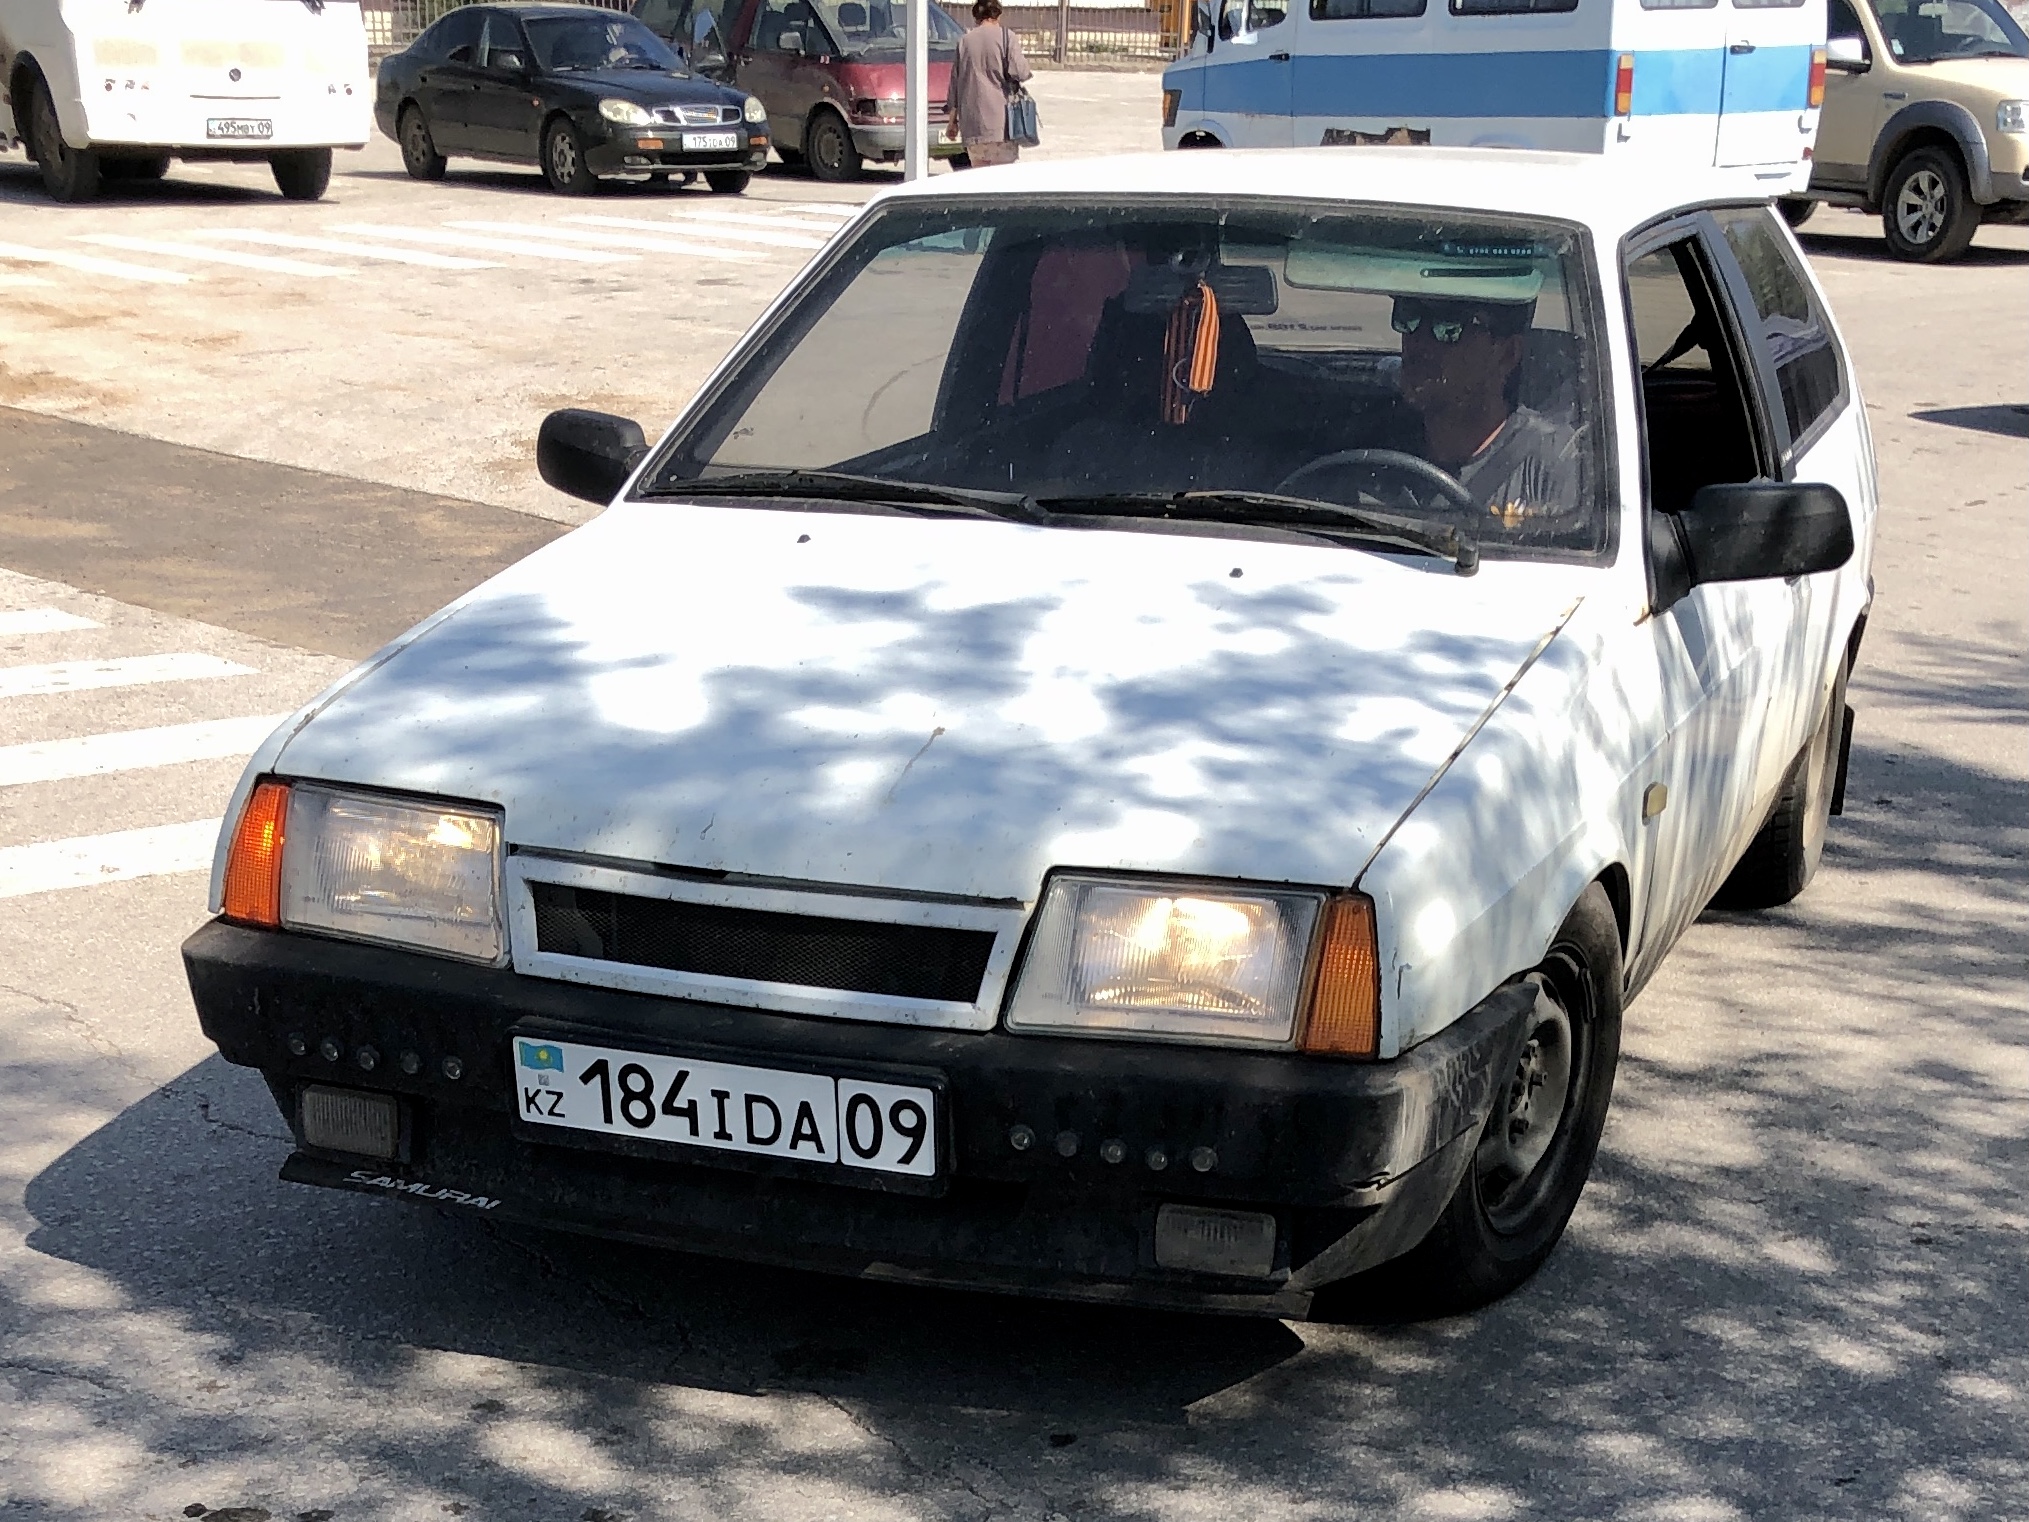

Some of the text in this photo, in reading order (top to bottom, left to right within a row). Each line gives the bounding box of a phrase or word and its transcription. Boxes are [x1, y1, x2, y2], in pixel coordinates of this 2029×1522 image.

[523, 1086, 566, 1118] KZ
[578, 1058, 928, 1165] 184IDA 09
[343, 1170, 502, 1210] SAMURAI
